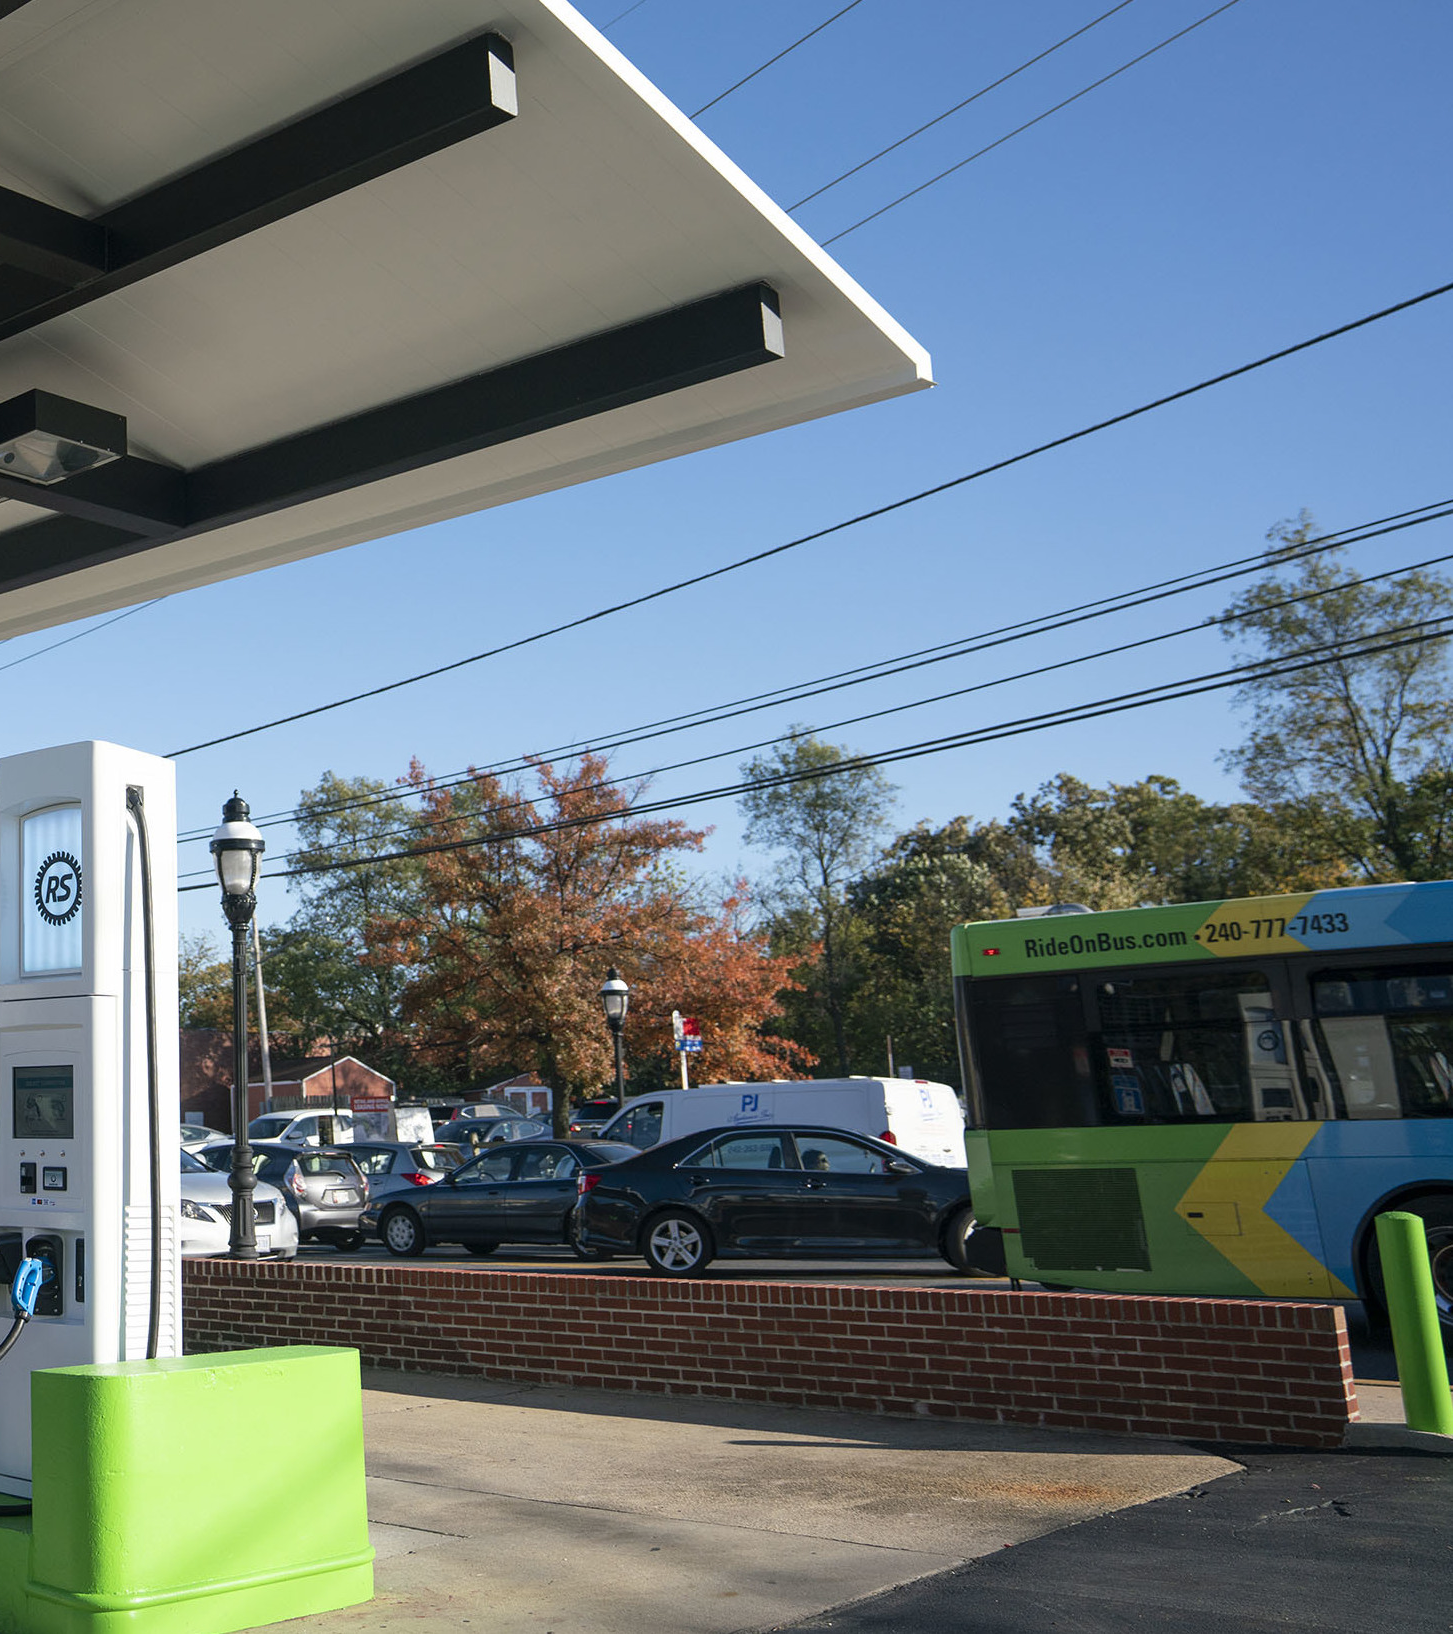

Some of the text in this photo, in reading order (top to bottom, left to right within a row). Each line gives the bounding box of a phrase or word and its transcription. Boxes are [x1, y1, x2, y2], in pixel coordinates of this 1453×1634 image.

[45, 873, 73, 903] RS
[1024, 912, 1349, 958] RideOnBus.com 240-777-7433
[741, 1093, 759, 1112] PJ
